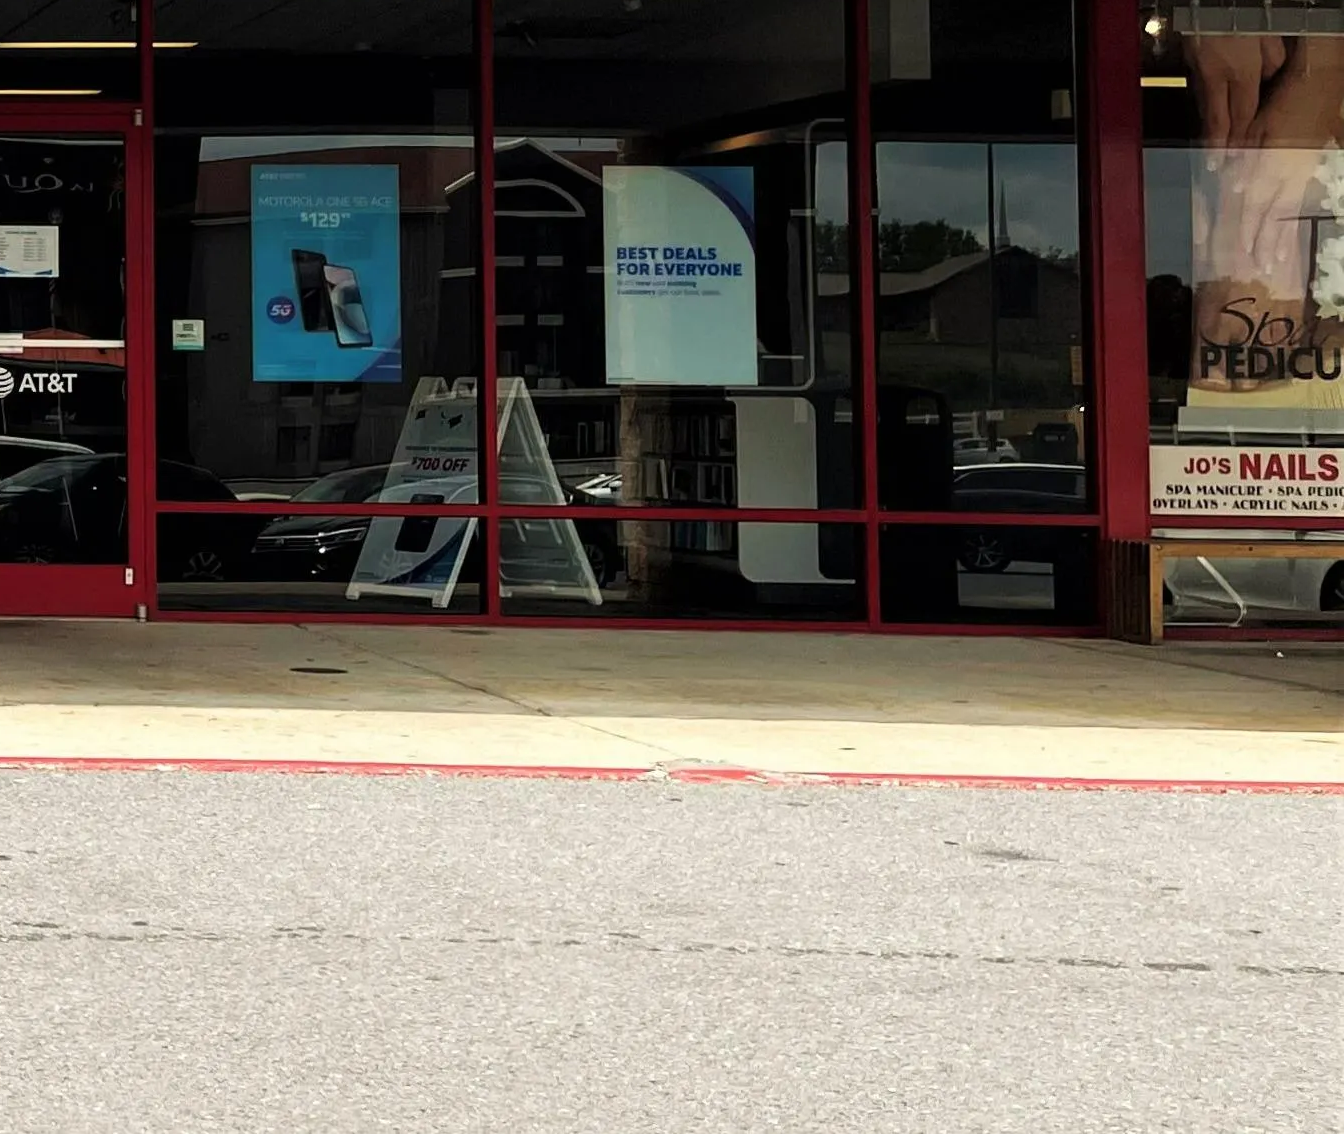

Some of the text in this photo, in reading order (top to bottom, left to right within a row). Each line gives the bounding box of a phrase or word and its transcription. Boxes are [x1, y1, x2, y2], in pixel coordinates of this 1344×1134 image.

[258, 195, 324, 208] MOTOROLA
[370, 195, 393, 207] ACE
[616, 247, 718, 260] BEST DEALS
[616, 263, 743, 277] FOR EVERYONE
[269, 304, 293, 317] 5G
[18, 372, 78, 394] AT&T
[442, 458, 470, 473] OFF
[1183, 452, 1340, 482] JO'S NAILS
[1165, 484, 1191, 496] SPA
[1196, 484, 1263, 497] MANICURE
[1277, 485, 1302, 497] SPA
[1152, 498, 1219, 510] OVERLAYS
[1231, 498, 1287, 511] ACRYLIC
[1291, 499, 1329, 511] NAILS
